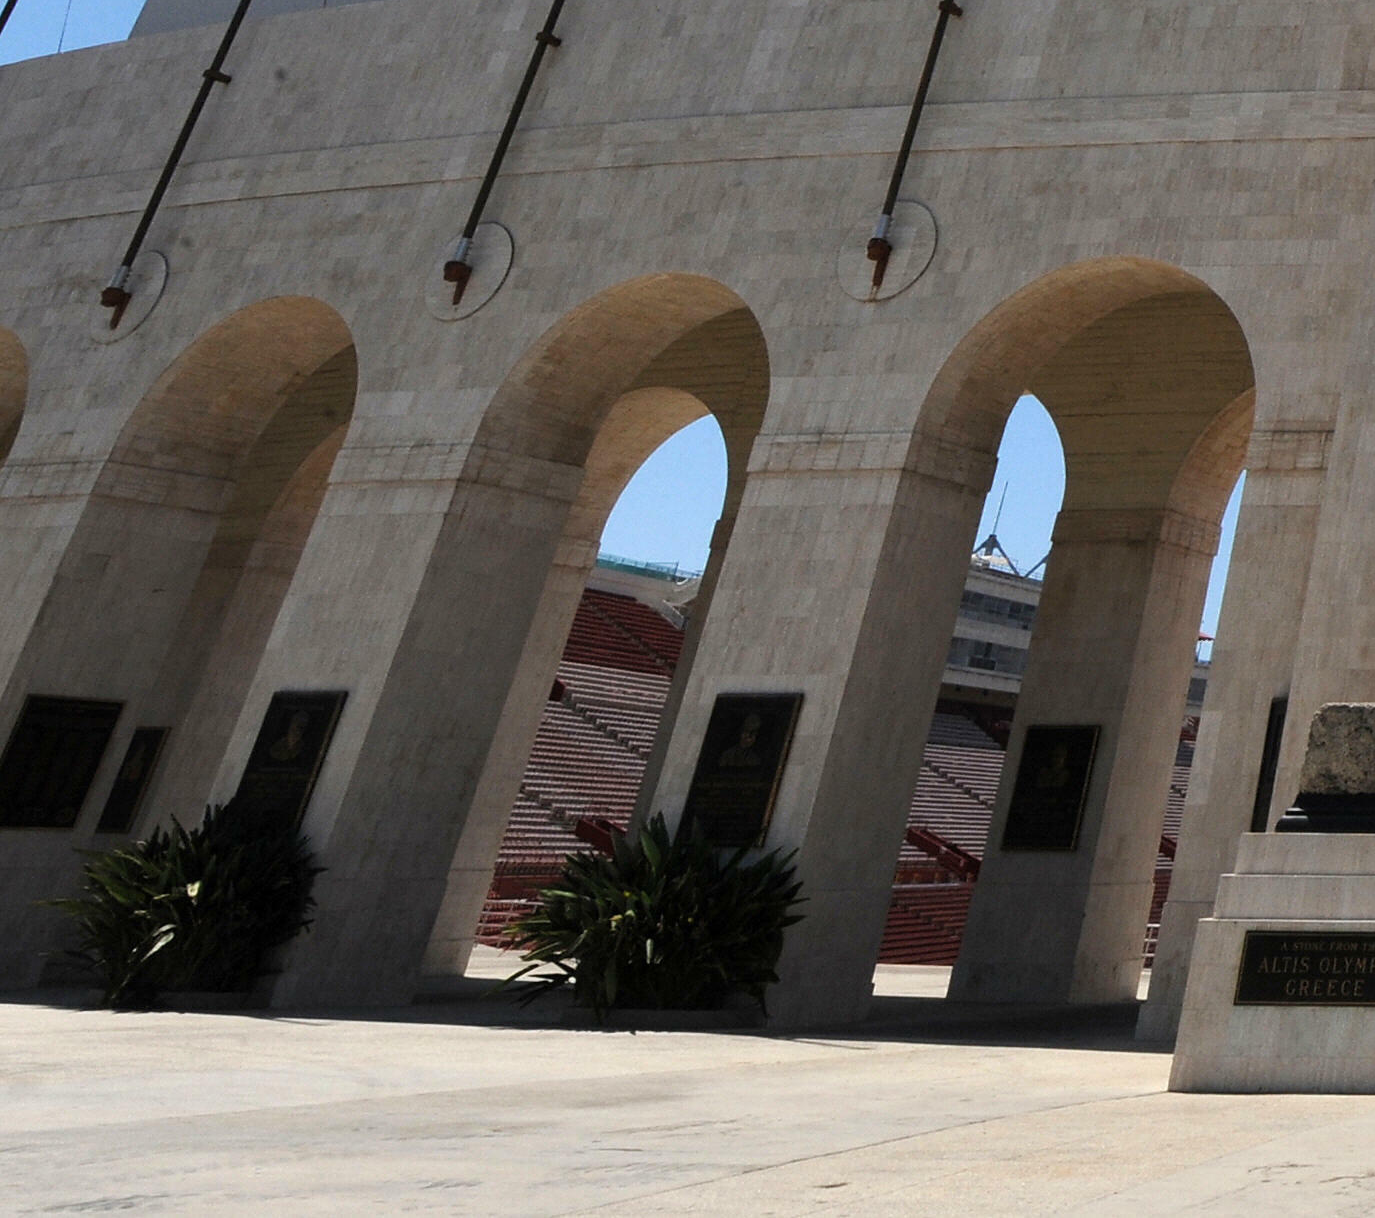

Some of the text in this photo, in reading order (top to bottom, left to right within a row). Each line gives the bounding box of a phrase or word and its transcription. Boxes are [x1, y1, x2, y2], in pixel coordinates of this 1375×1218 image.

[1280, 941, 1289, 951] A
[1293, 941, 1326, 951] STONE
[1329, 941, 1358, 951] FROM
[1257, 956, 1311, 974] ALTIS
[1285, 979, 1366, 997] GREECE
